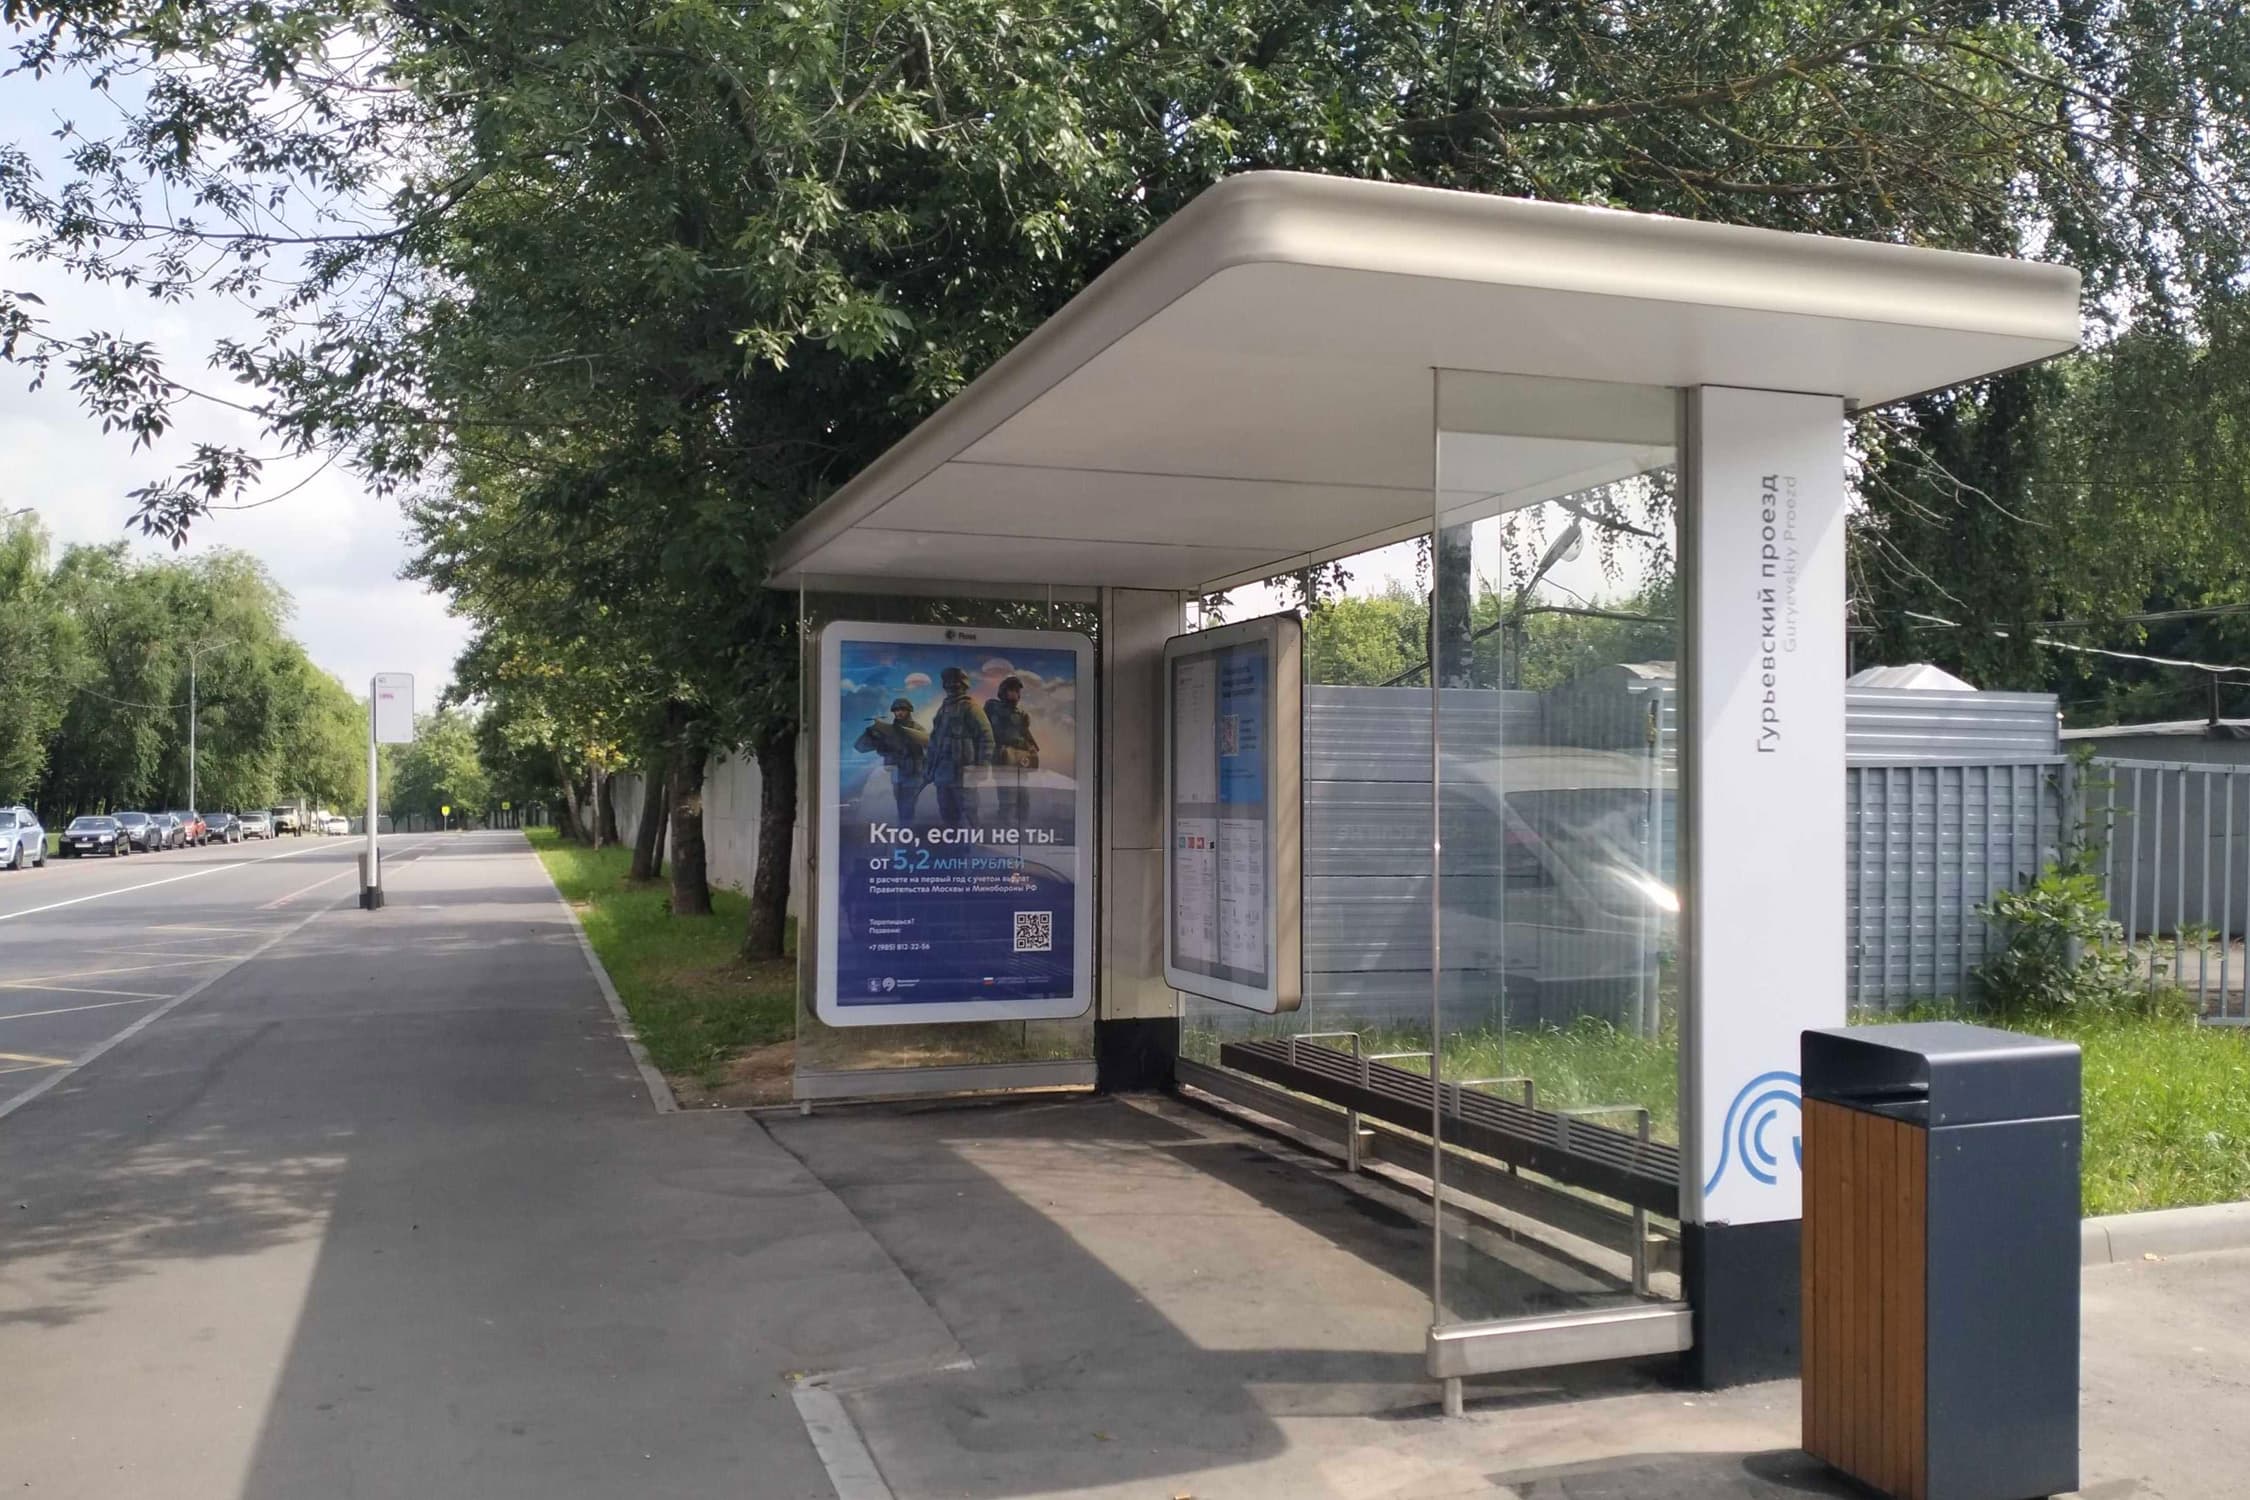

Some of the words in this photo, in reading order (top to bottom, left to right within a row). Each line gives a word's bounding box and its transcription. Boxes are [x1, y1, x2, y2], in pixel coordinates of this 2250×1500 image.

[1762, 474, 1779, 577] проезд
[1783, 476, 1797, 541] Proezd
[1783, 547, 1799, 652] Guryevskiy
[1757, 588, 1780, 752] Гурьевский
[870, 823, 920, 847] Кто,
[927, 828, 984, 844] если
[992, 828, 1020, 844] не
[870, 858, 890, 870] от
[893, 849, 930, 873] 5,2
[933, 858, 968, 870] МЛН
[971, 856, 1025, 870] РУБЛЕЙ
[921, 875, 951, 884] первый
[869, 886, 930, 895] Правительства
[972, 884, 1024, 893] Минобороны
[1025, 884, 1038, 892] РФ
